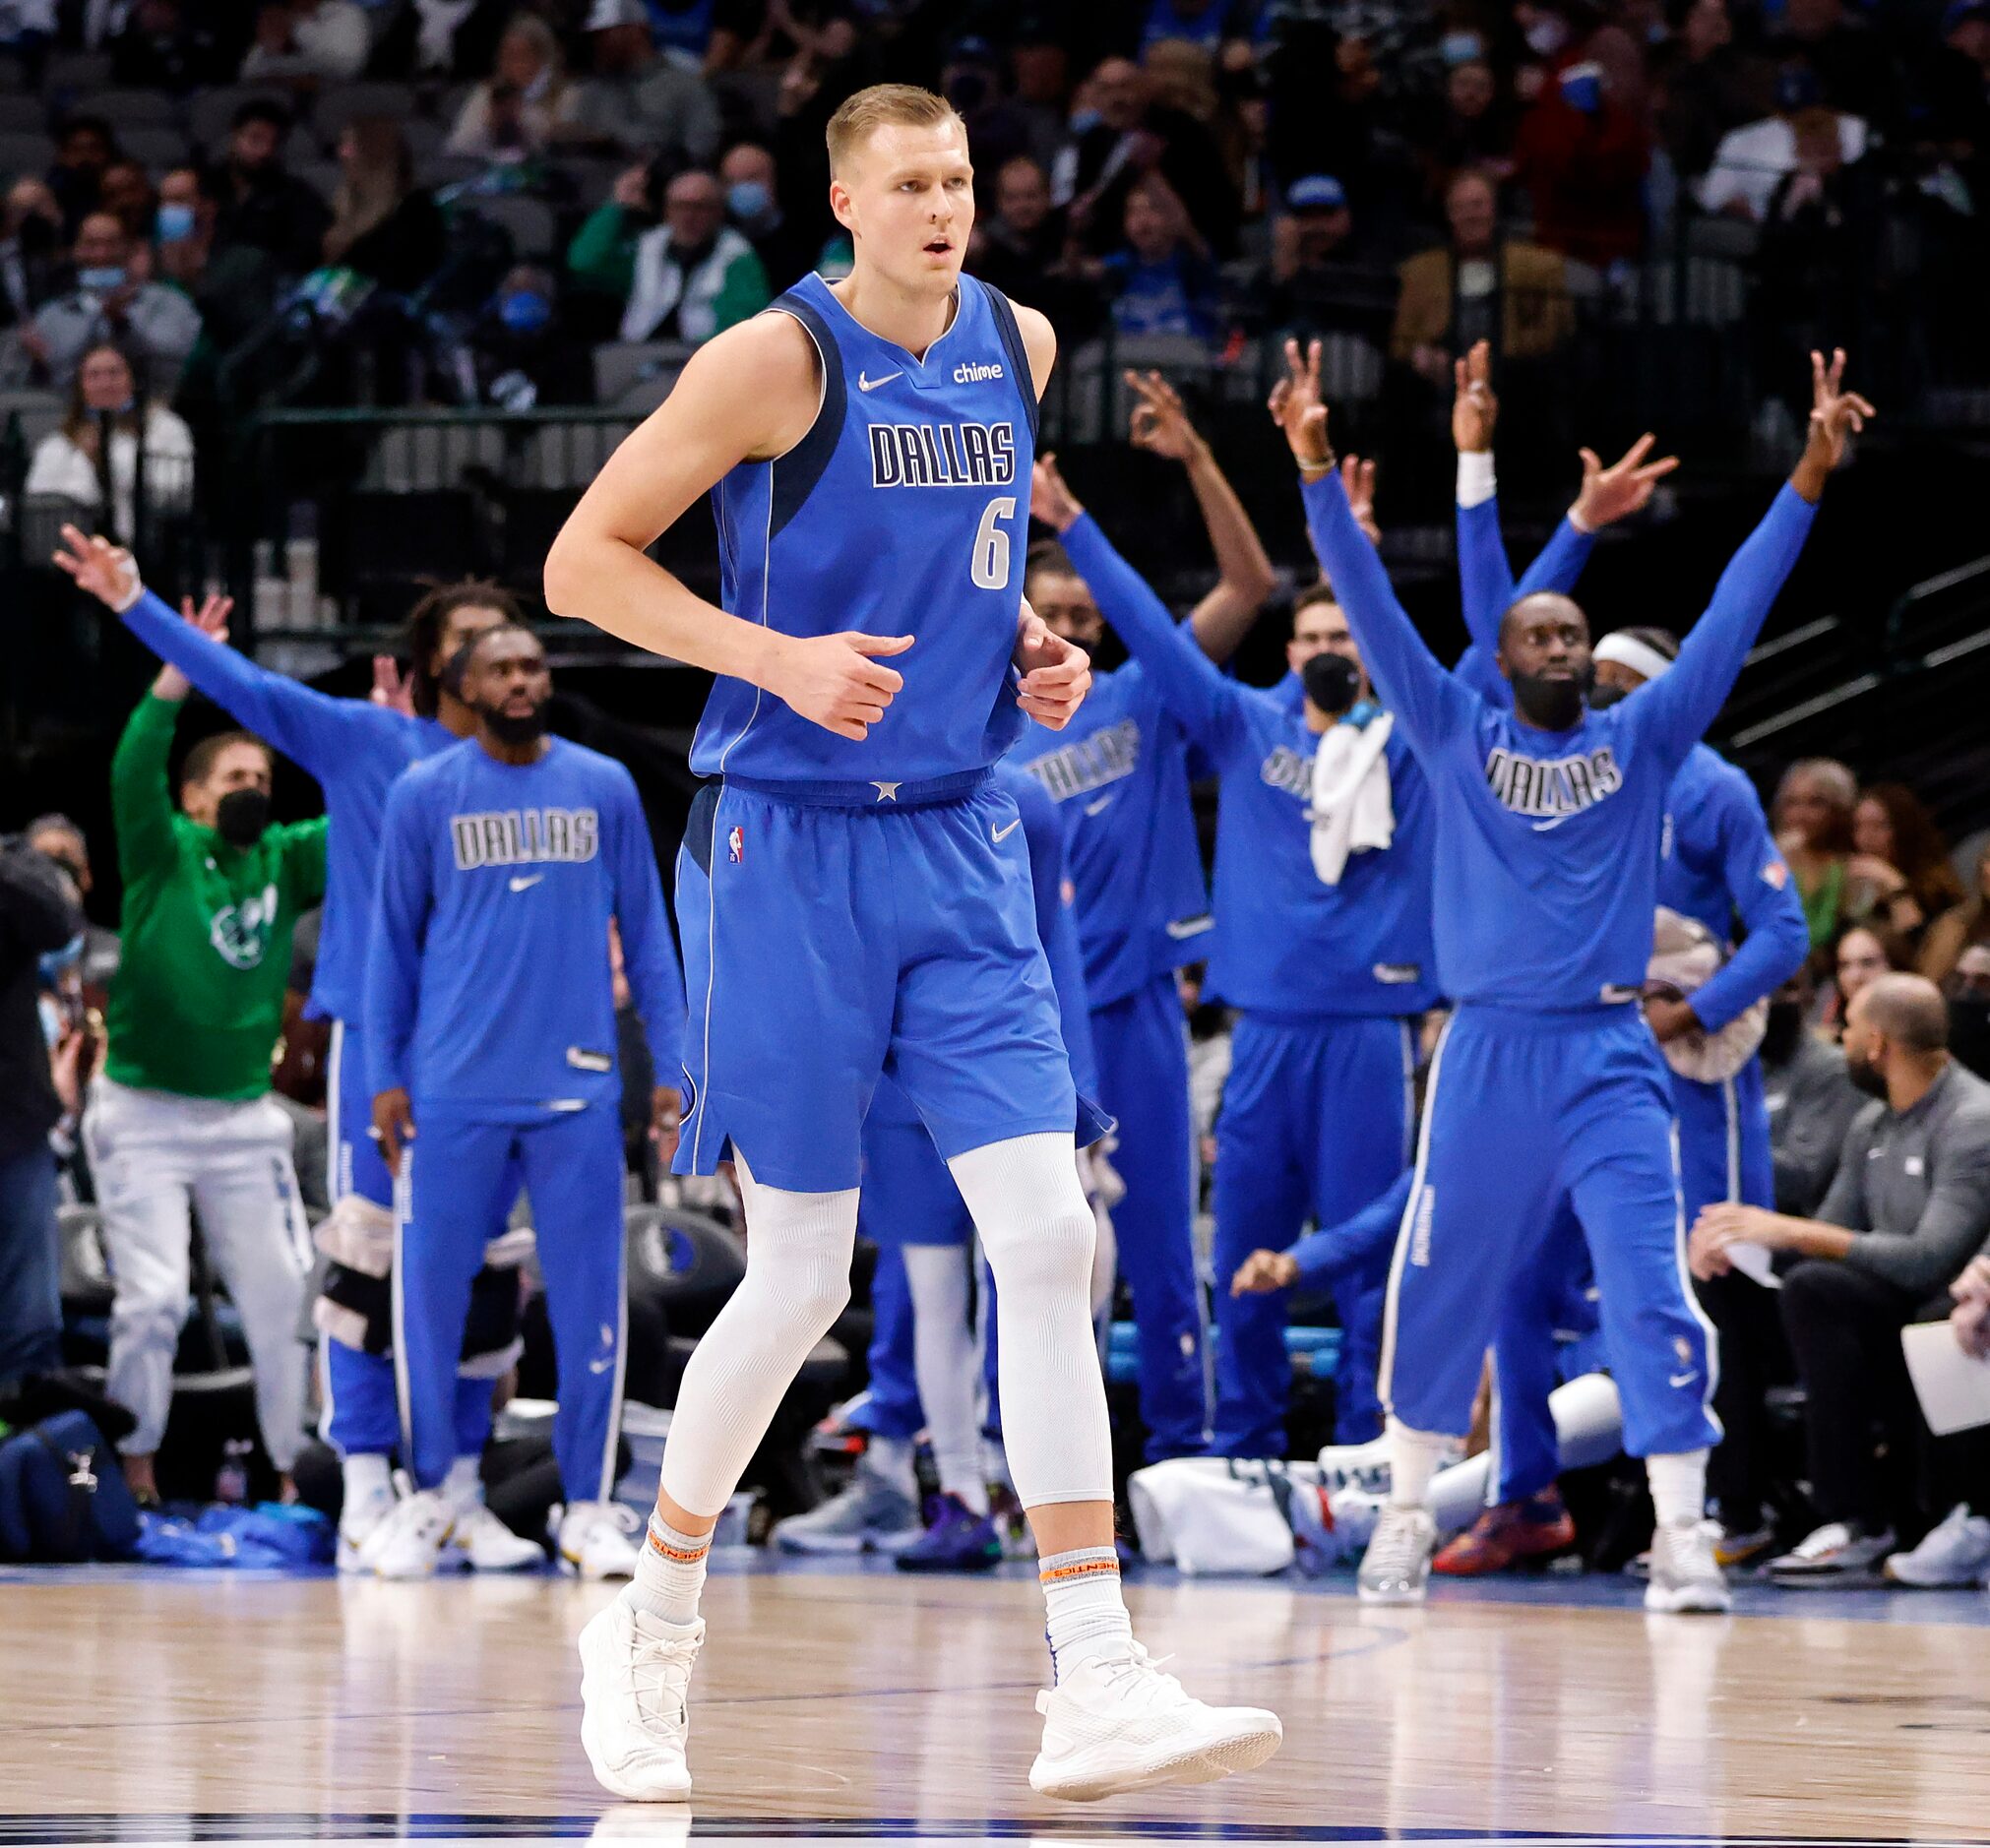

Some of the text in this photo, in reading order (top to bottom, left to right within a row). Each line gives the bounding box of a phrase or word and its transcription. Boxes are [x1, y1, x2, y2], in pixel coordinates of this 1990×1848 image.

[954, 362, 1003, 384] chime
[868, 421, 1015, 488] DALLAS
[971, 497, 1016, 590] 6
[450, 807, 598, 871] DALLAS
